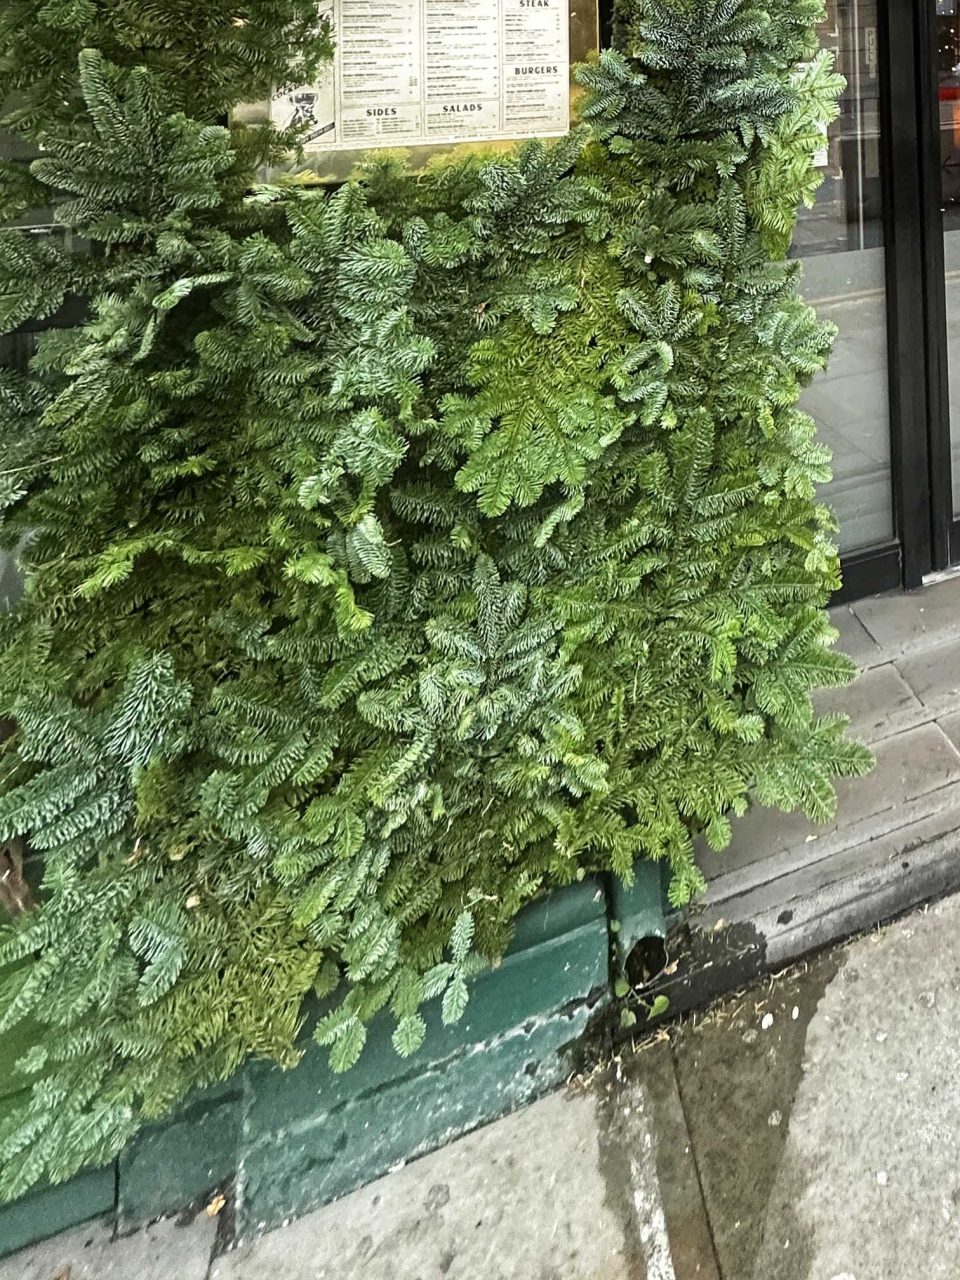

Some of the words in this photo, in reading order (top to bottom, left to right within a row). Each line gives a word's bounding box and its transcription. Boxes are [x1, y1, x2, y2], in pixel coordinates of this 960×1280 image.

[520, 0, 549, 8] STEAK
[515, 66, 558, 75] BURGERS
[366, 108, 397, 116] SIDES
[442, 103, 483, 113] SALADS
